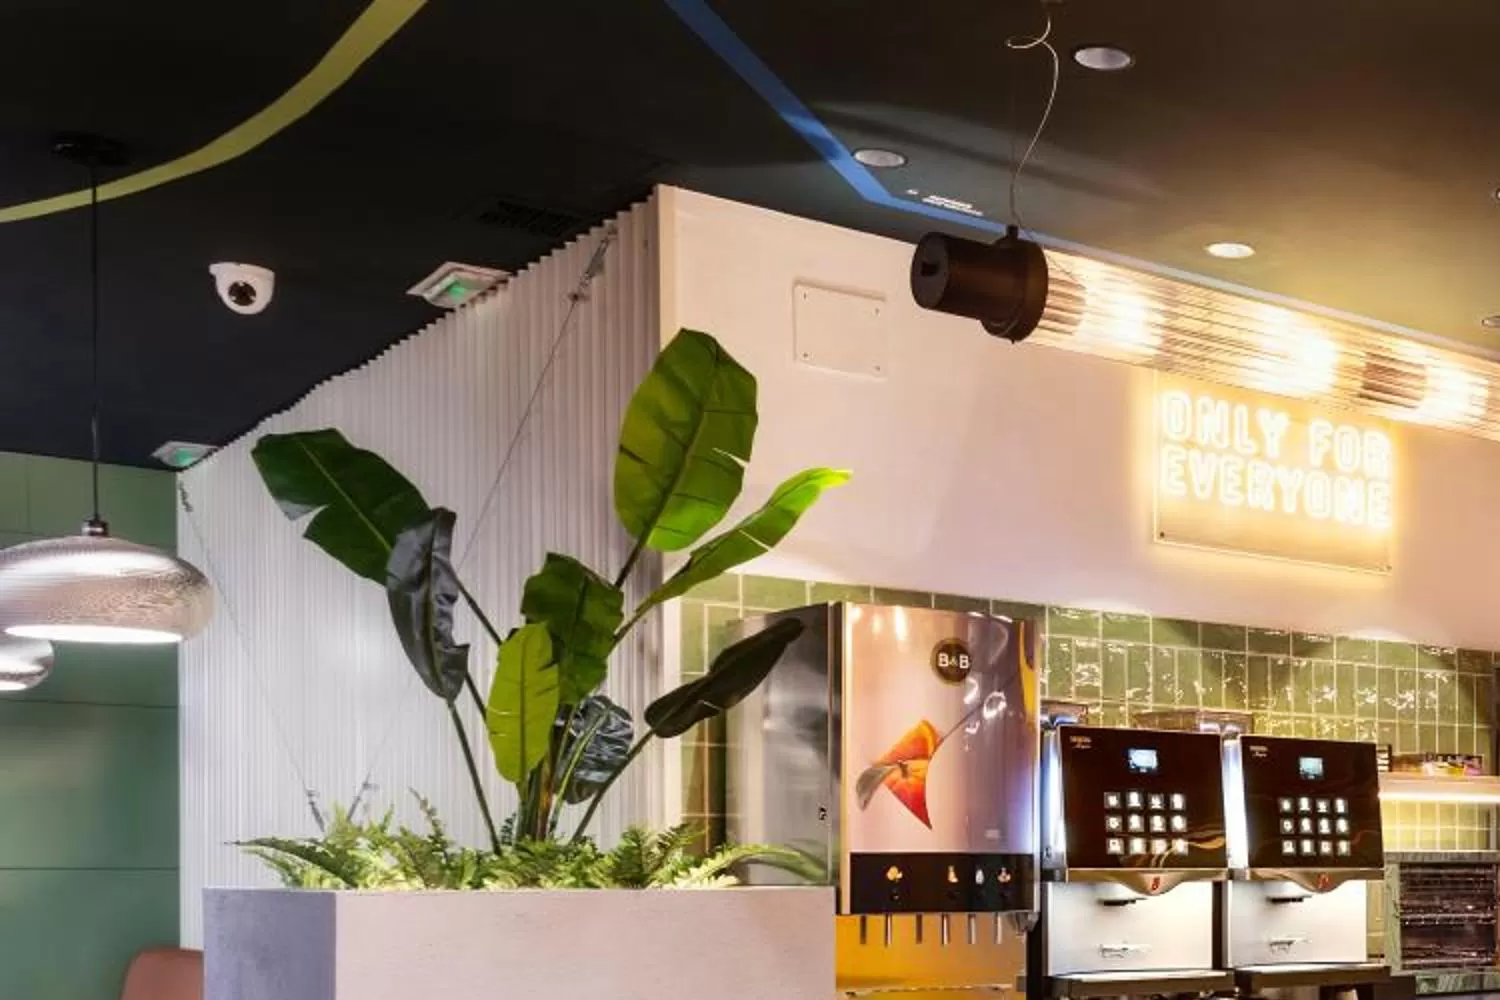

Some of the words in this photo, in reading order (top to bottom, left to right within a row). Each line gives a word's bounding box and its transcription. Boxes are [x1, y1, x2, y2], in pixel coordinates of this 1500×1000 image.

[1159, 389, 1289, 459] ONLY
[1309, 418, 1392, 479] FOR
[1159, 444, 1393, 528] EVERYONE
